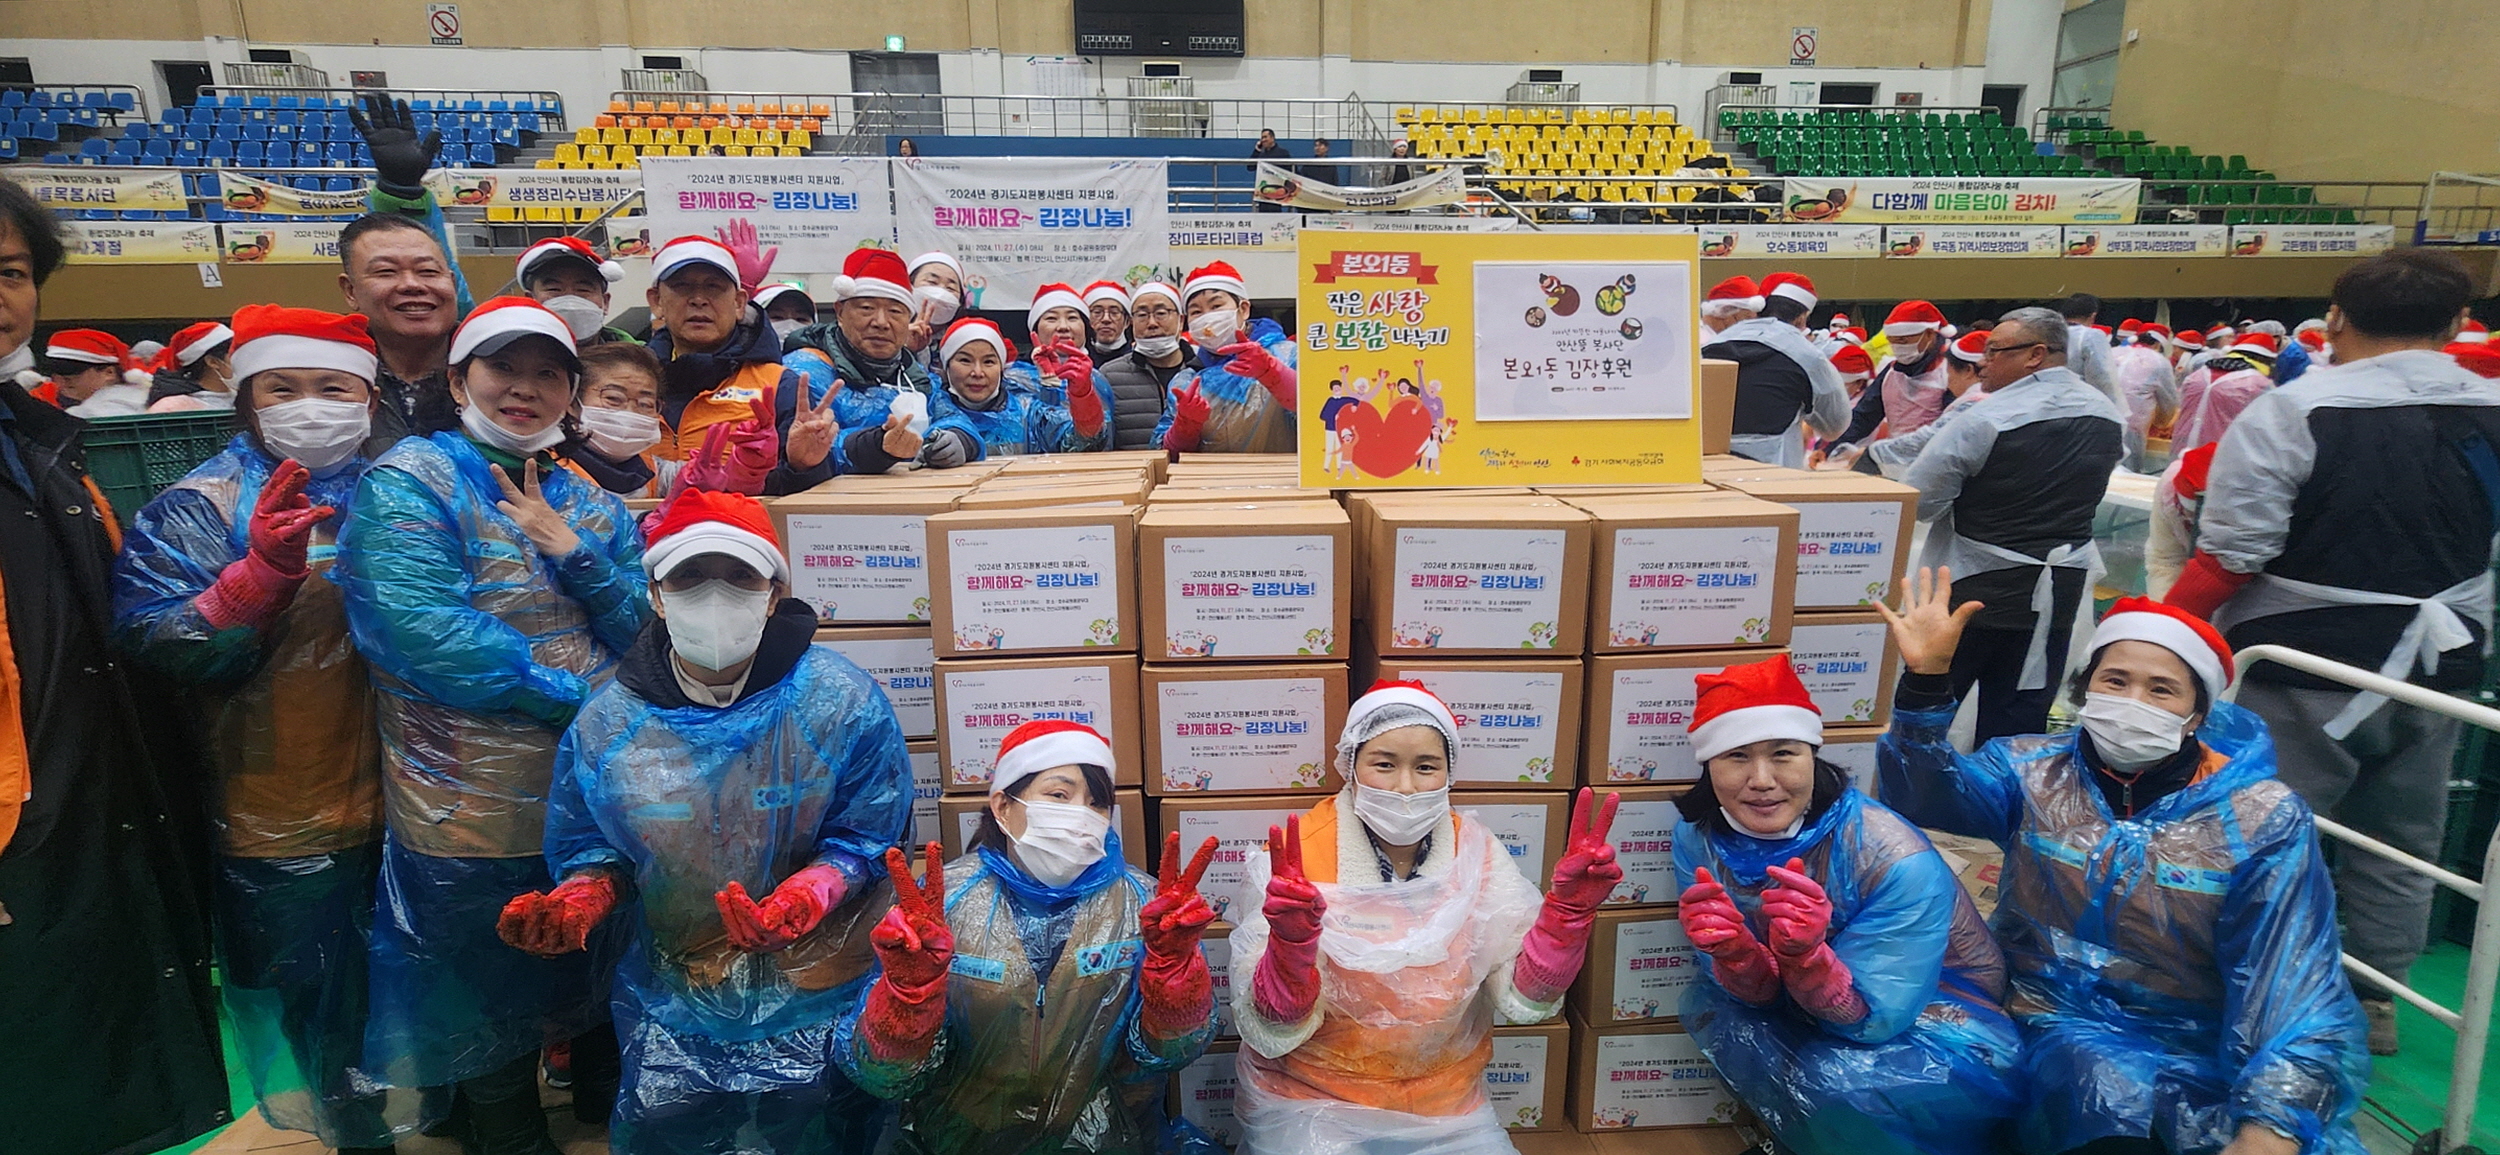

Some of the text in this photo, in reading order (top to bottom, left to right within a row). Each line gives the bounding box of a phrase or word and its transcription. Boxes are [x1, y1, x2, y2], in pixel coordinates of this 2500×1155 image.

[52, 175, 121, 184] 통합김장나눔 축제
[729, 175, 803, 185] 경기도자원봉사센터
[1912, 181, 2020, 190] 2024 안산시 통합김장나눔 축제
[34, 186, 116, 203] 들목봉사단
[509, 187, 631, 201] 생생정리수납봉사단
[678, 191, 858, 210] 함께해요~ 김장나눔!
[991, 189, 1074, 200] 경기도자원봉사센터
[1872, 193, 1928, 211] 다함께
[1934, 193, 2009, 211] 마음담아
[2015, 193, 2055, 211] 김치!
[934, 206, 1132, 228] 함께해요~ 김장나눔!
[1170, 220, 1251, 229] 안산시 통합김장나눔 축제
[139, 229, 155, 237] 축제
[1168, 231, 1263, 246] 장미로타리클럽
[1766, 241, 1828, 253] 호수동체육회
[1932, 241, 1957, 253] 부곡동
[1958, 241, 2029, 253] 지역사회보장협의체
[1342, 254, 1410, 275] 본오1동
[205, 264, 220, 283] A
[1328, 290, 1428, 323] 작은 사랑
[1308, 321, 1448, 349] 큰 보람 나누기
[1556, 338, 1624, 352] 안산뜰 봉사단
[1503, 357, 1633, 380] 본오1동 김장후원
[1829, 542, 1882, 555] 김장나눔!
[804, 554, 921, 569] 함께해요~ 김장나눔!
[967, 572, 1098, 590] 함께해요~ 김장나눔!
[1411, 574, 1544, 589] 함께해요~ 김장나눔!
[1628, 573, 1757, 588] 함께해요~ 김장나눔!
[1182, 582, 1315, 597] 함께해요~ 김장나눔!
[1817, 661, 1867, 674] 김장나눔!
[1480, 714, 1541, 728] 김장나눔!
[1627, 712, 1691, 726] 함께해요~
[1177, 720, 1307, 736] 함께해요~ 김장나눔!
[1630, 956, 1689, 971] 함께해요~
[1486, 1071, 1531, 1085] 장나눔!
[1611, 1068, 1669, 1083] 함께해요~
